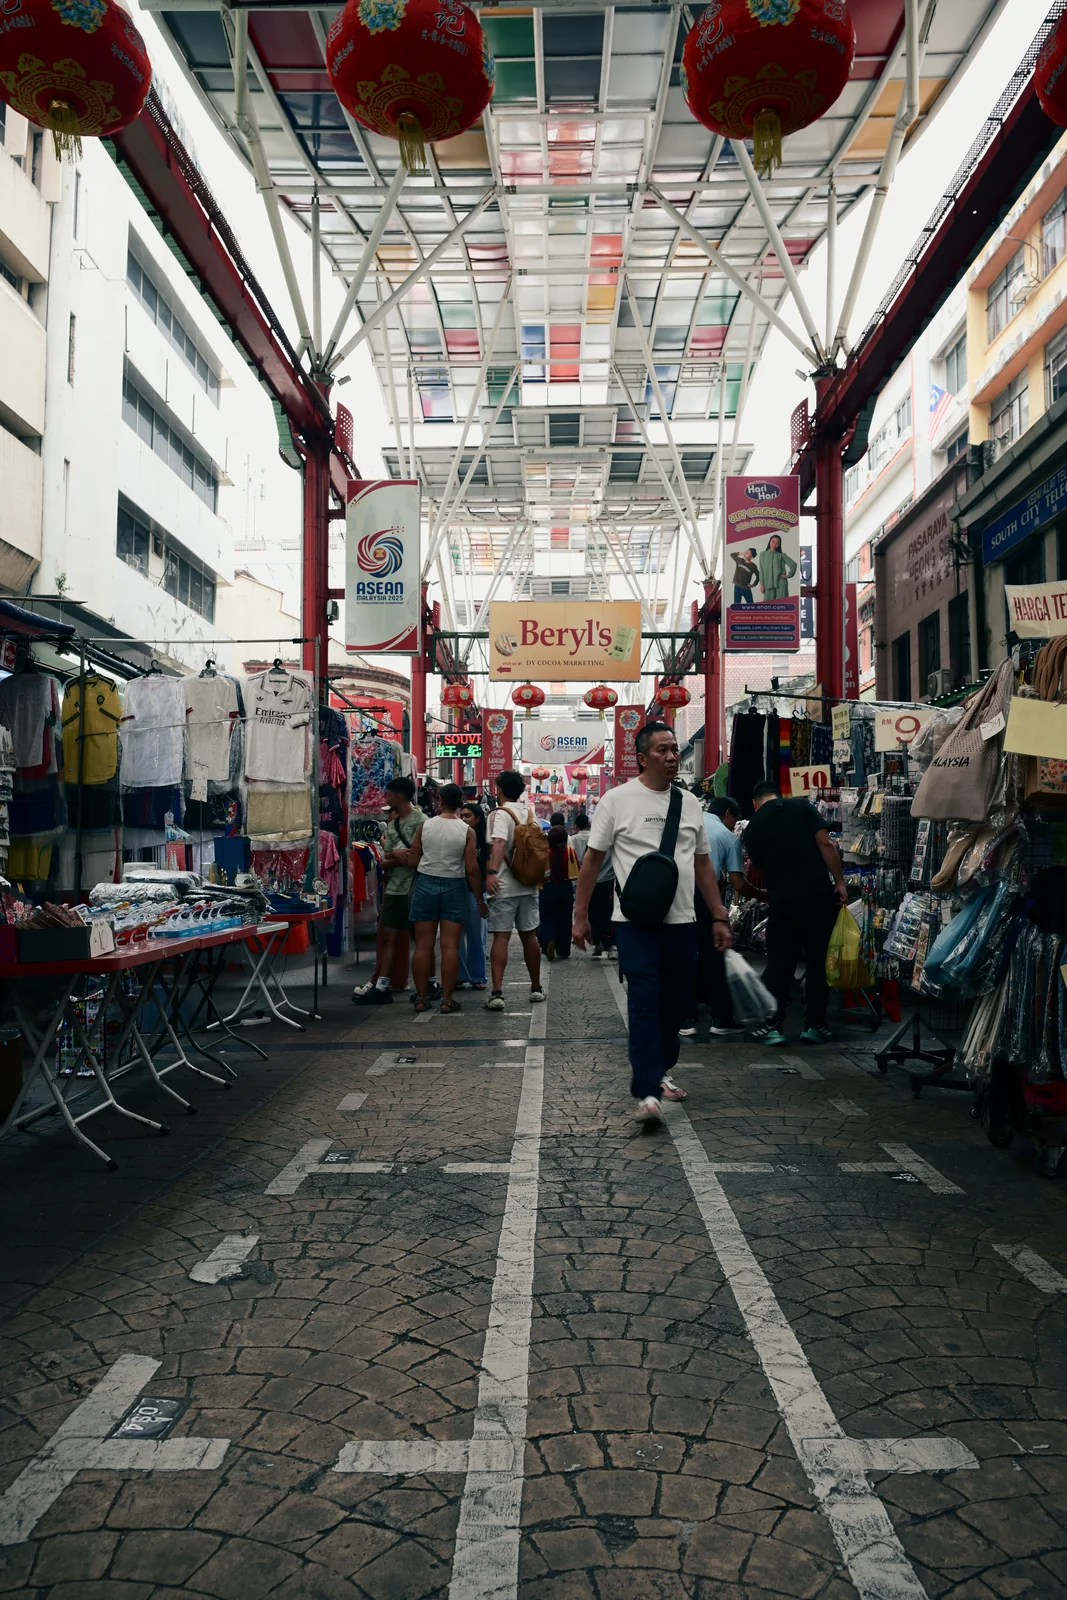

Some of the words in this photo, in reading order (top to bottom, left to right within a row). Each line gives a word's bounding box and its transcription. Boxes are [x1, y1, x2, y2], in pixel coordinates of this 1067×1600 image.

[748, 484, 767, 494] Hari
[758, 490, 777, 500] Hari
[729, 509, 747, 523] BUY
[747, 507, 777, 518] ONLINE
[778, 509, 797, 523] NOW
[991, 519, 1018, 549] SOUTH
[1020, 501, 1040, 526] CITY
[909, 511, 947, 560] PASARAYA
[356, 581, 404, 595] ASEAN
[1013, 595, 1052, 621] HARGA
[1051, 592, 1067, 620] TE
[519, 618, 612, 656] Beryl's
[255, 706, 292, 720] Emirates
[881, 718, 892, 726] RM
[895, 715, 921, 744] 9
[557, 736, 588, 746] ASEAN
[800, 770, 828, 790] 10
